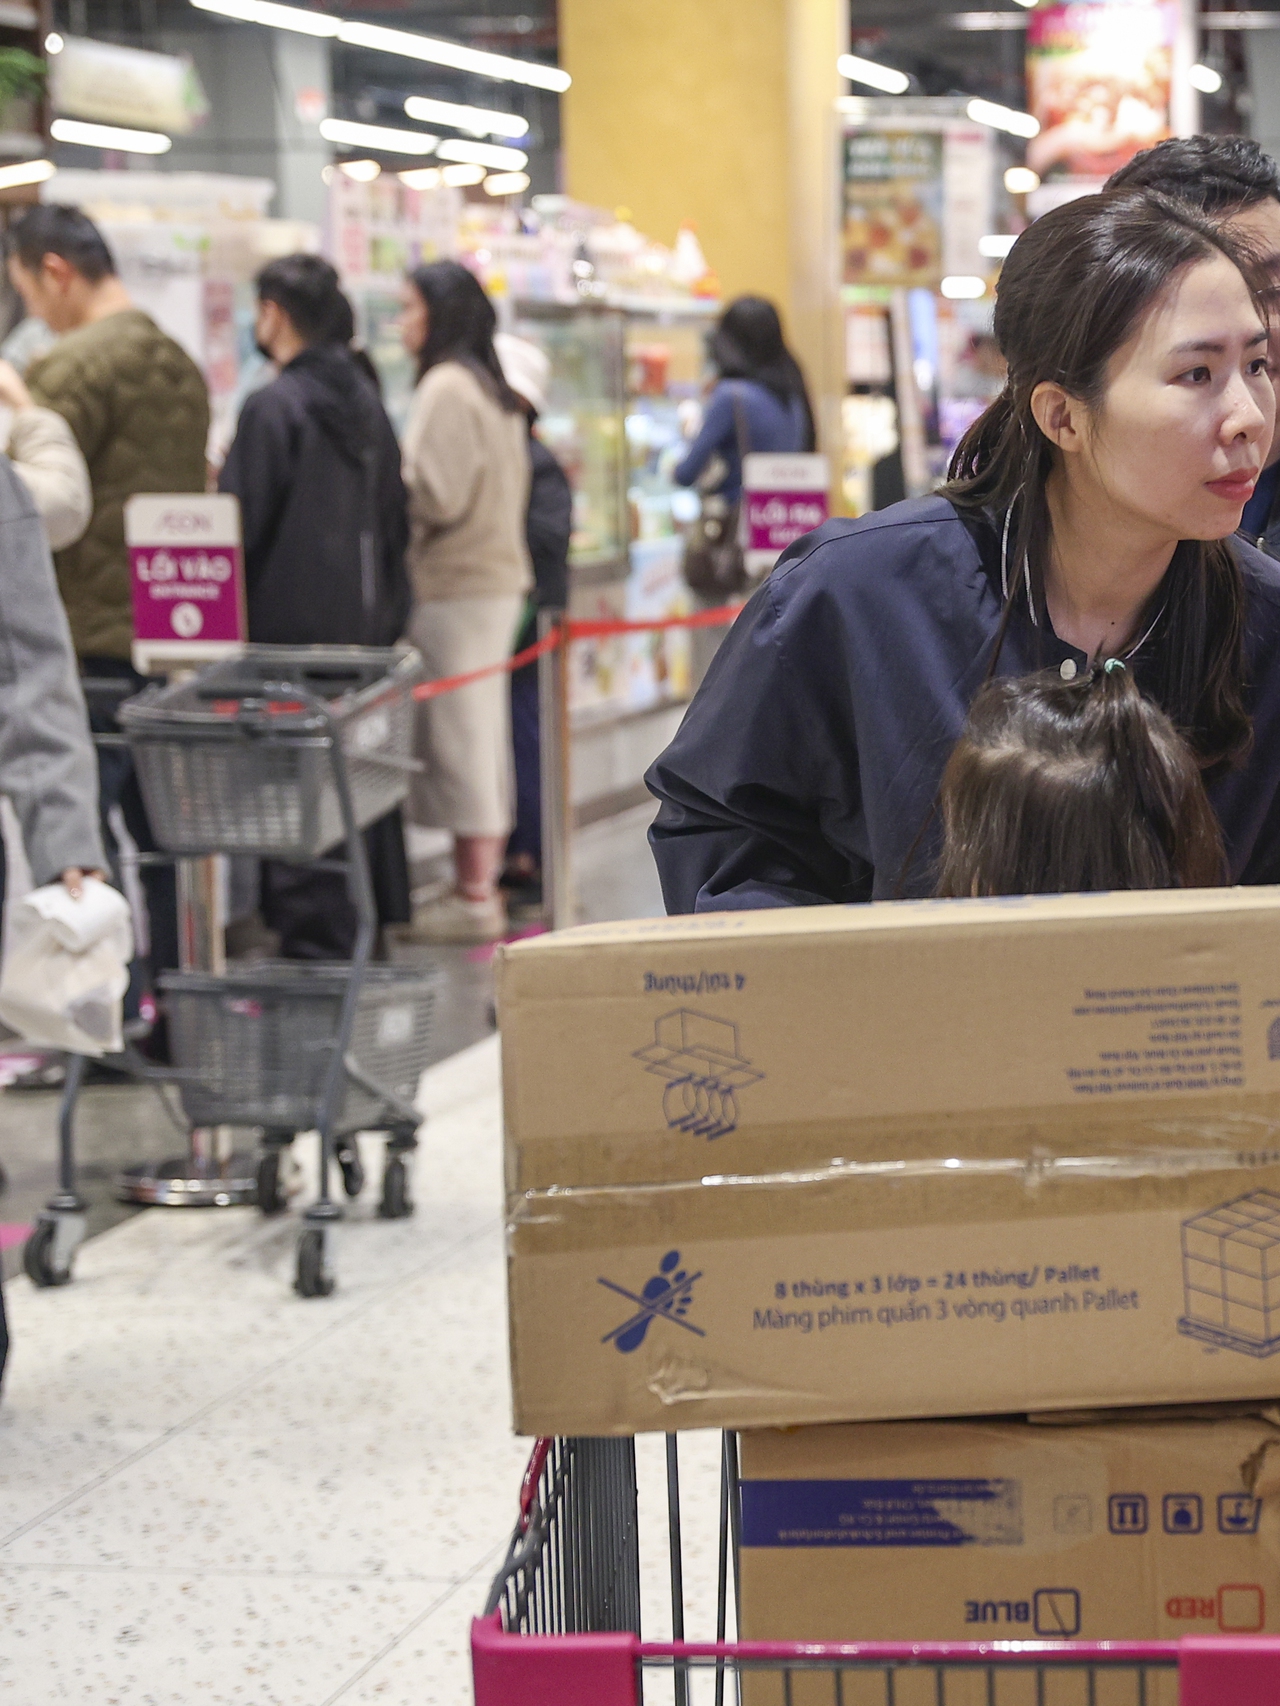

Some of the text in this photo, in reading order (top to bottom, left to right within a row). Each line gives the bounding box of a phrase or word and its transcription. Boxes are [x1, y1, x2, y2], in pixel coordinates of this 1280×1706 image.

[774, 1281, 787, 1300] 8
[792, 1277, 849, 1300] thùng
[871, 1274, 882, 1294] 3
[887, 1272, 921, 1295] lớp
[943, 1271, 968, 1290] 24
[1044, 1264, 1101, 1284] Pallet
[752, 1304, 814, 1334] Màng
[817, 1304, 874, 1333] phim
[935, 1298, 949, 1321] 3
[952, 1298, 1006, 1323] vòng
[1009, 1290, 1080, 1321] quanh
[1082, 1287, 1139, 1312] Pallet
[964, 1600, 1030, 1623] BLUE
[1165, 1597, 1215, 1619] RED
